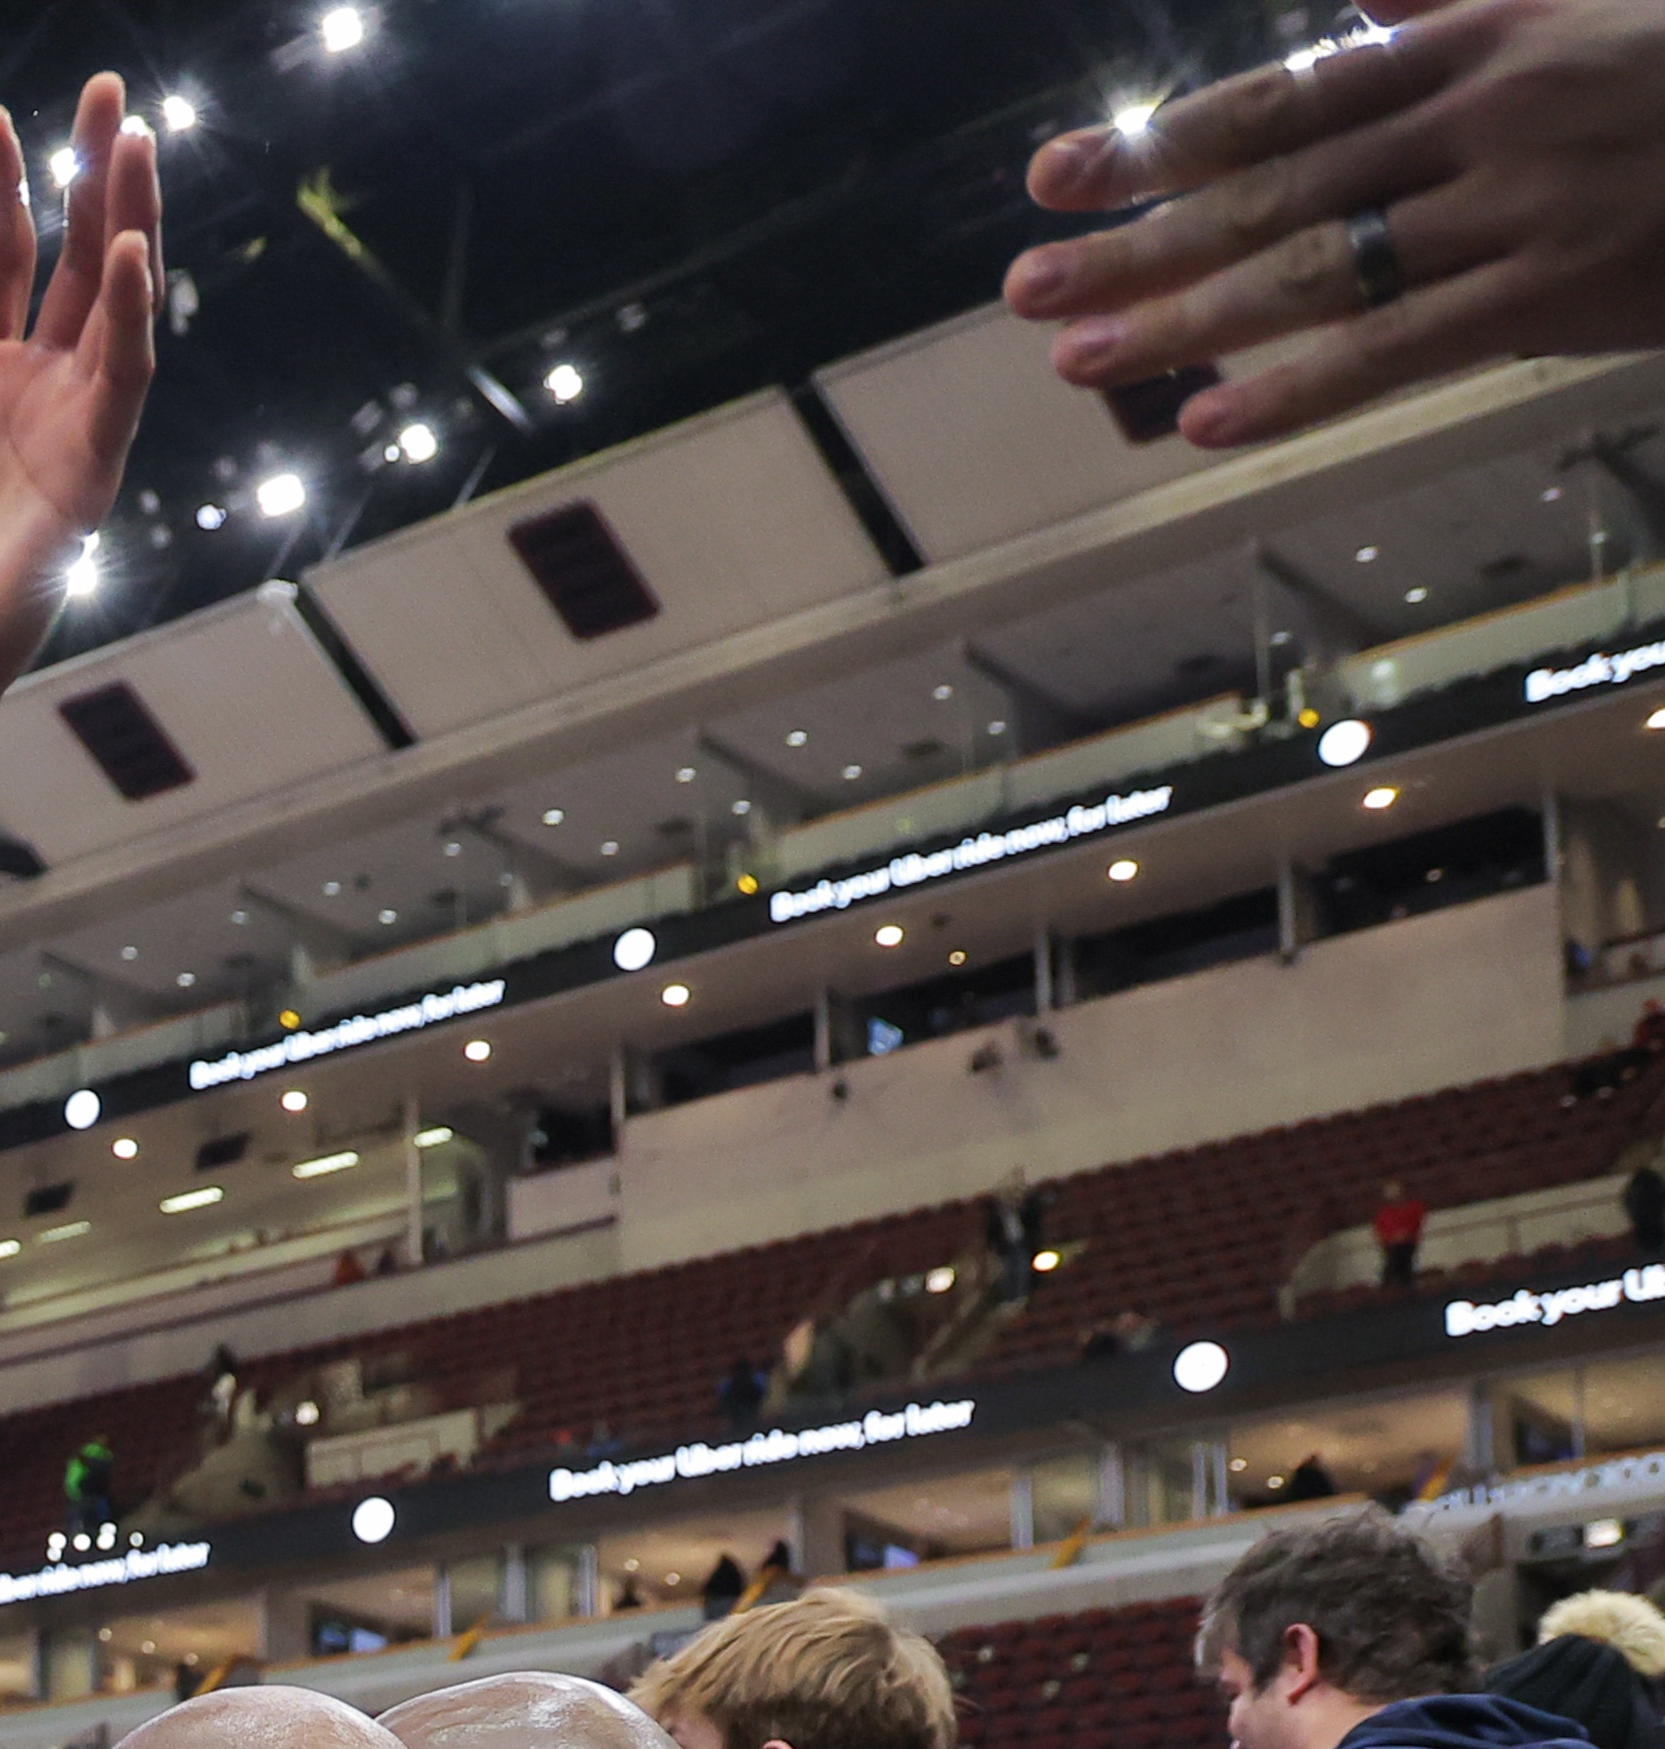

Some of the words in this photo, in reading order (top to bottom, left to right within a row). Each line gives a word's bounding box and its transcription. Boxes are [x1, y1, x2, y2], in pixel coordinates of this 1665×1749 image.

[1527, 654, 1612, 701] Book
[771, 881, 836, 921] Book
[827, 868, 891, 908] your
[888, 850, 956, 885] Uber
[951, 834, 1008, 869] ride
[1003, 818, 1070, 854] now,
[1066, 805, 1108, 835] for
[1104, 787, 1171, 824] later
[1447, 1290, 1542, 1335] Book
[1537, 1280, 1624, 1324] your
[551, 1462, 619, 1500] Book
[612, 1456, 676, 1494] your
[674, 1444, 743, 1477] Uber
[740, 1430, 800, 1465] ride
[796, 1422, 866, 1455] now,
[863, 1411, 906, 1443] for
[904, 1401, 974, 1435] later
